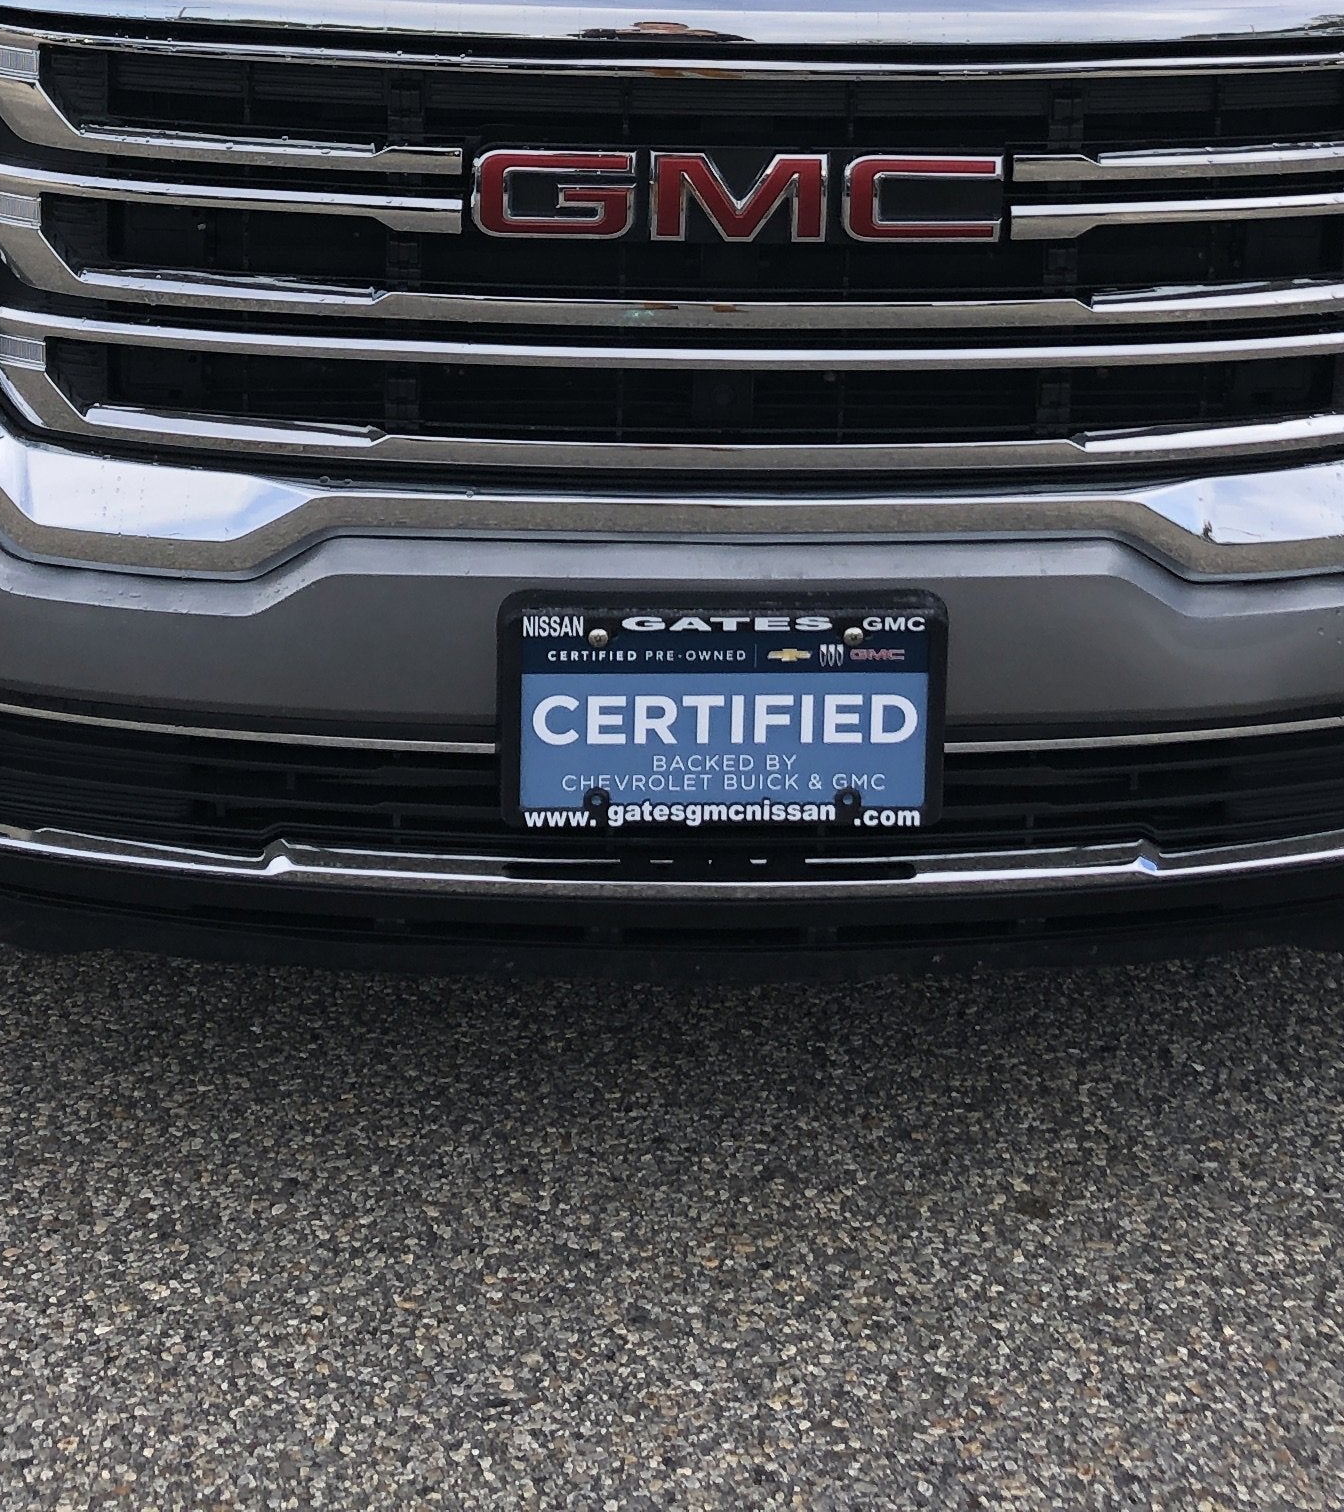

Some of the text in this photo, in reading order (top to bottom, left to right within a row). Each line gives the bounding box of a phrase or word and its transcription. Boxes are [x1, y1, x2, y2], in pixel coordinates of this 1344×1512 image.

[472, 148, 1005, 243] GMC
[522, 615, 927, 638] NISSAN GATES GMC
[547, 649, 638, 662] CERTIFIED
[849, 648, 906, 662] GMC
[532, 693, 919, 746] CERTIFIED
[652, 753, 798, 772] BACKED BY
[561, 772, 887, 792] CHEVROLET BUICK & GMC
[524, 799, 922, 828] www. gatesgmcnissan .com
